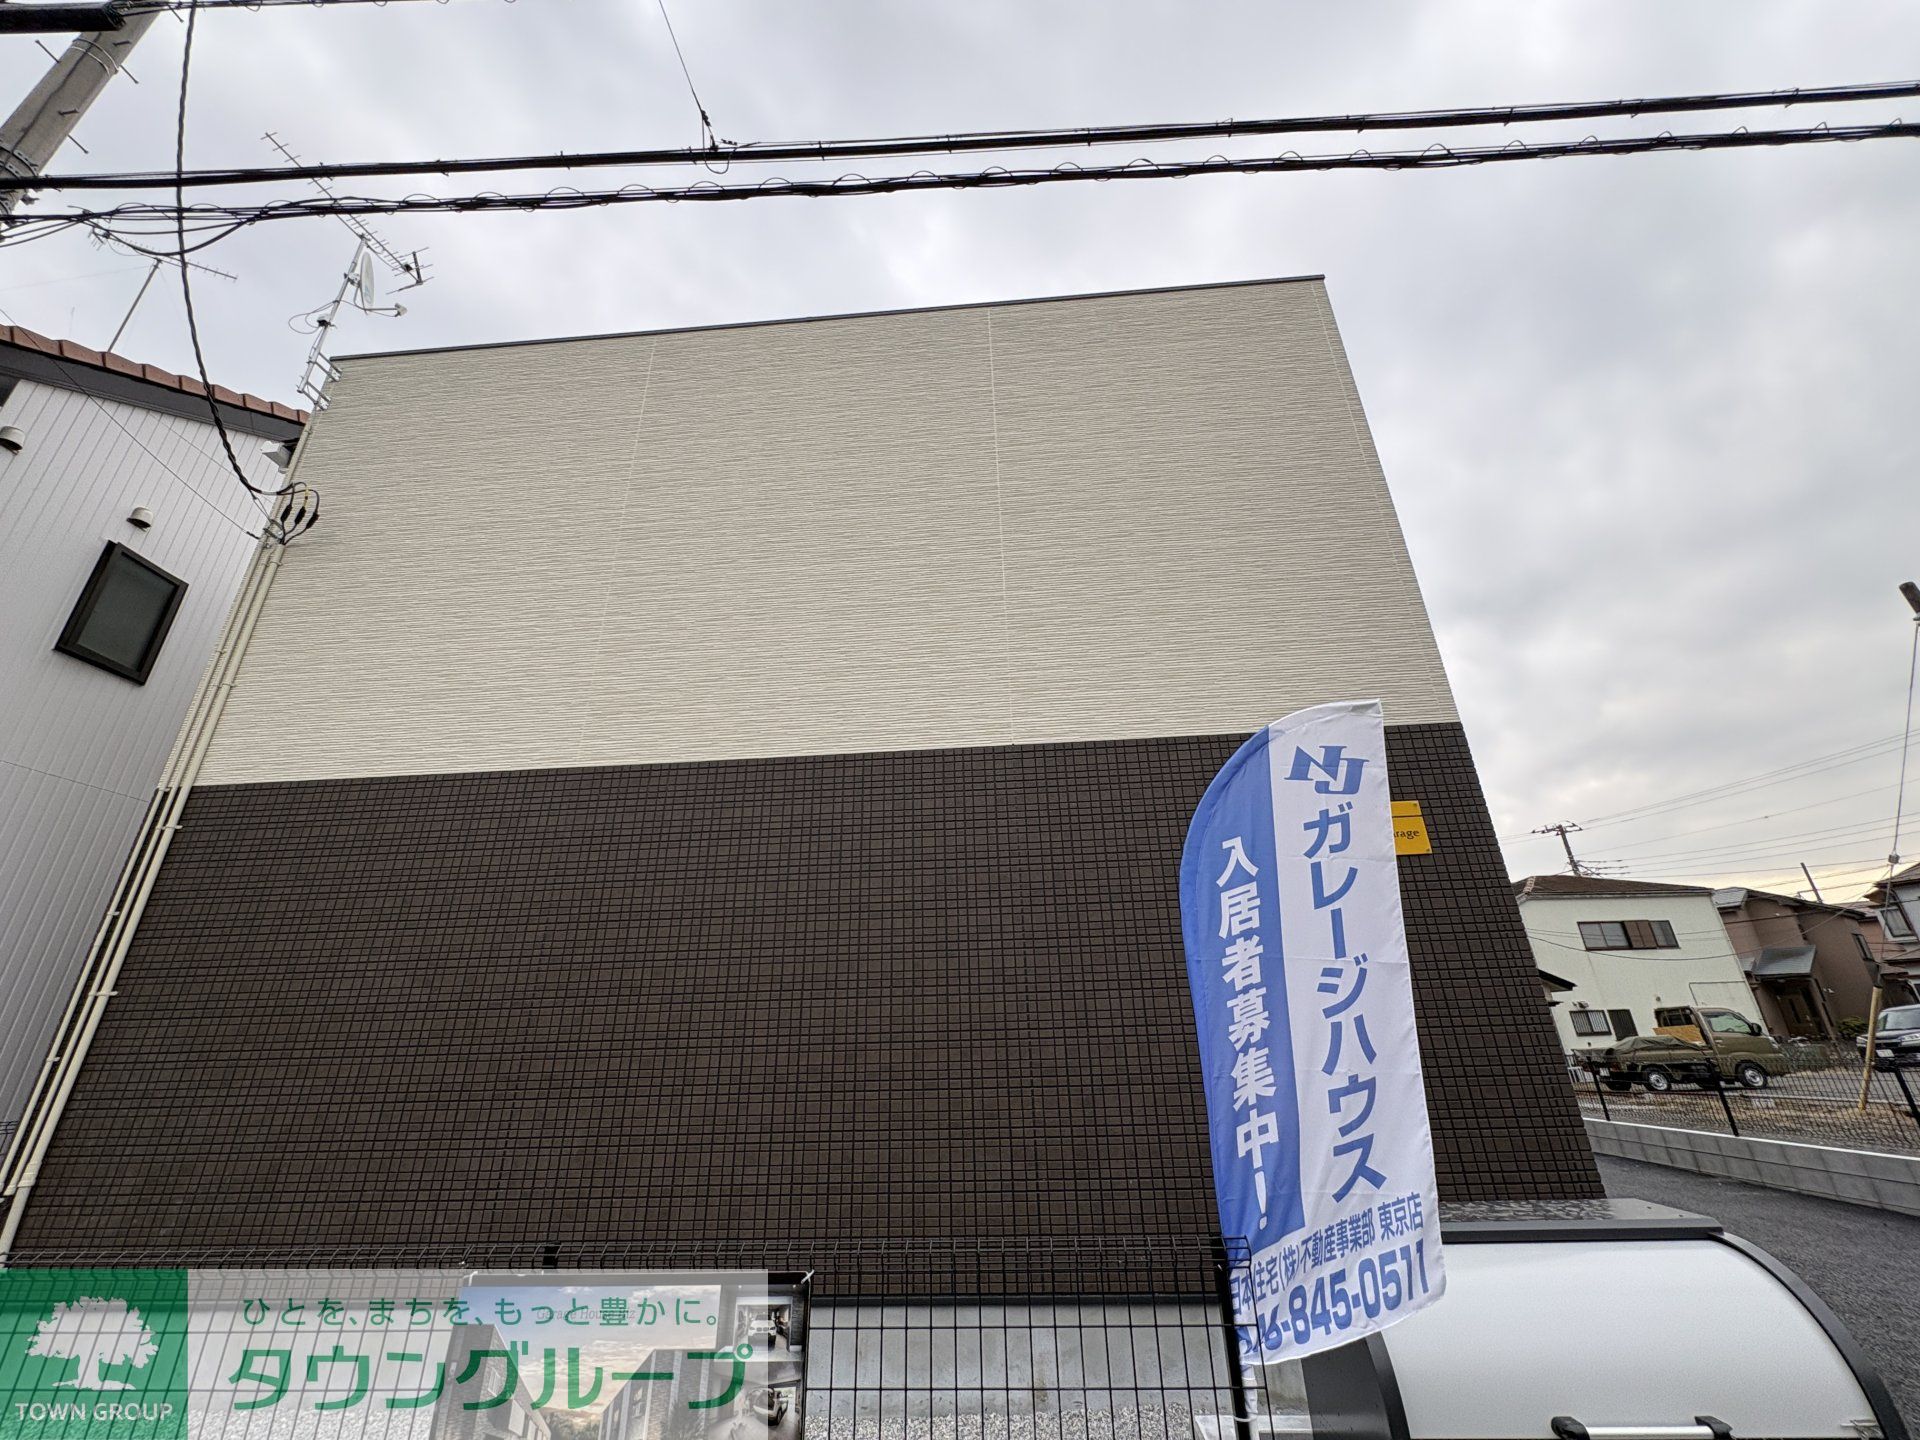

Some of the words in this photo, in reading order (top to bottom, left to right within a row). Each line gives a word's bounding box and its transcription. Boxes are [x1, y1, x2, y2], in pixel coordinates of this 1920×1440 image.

[1284, 745, 1370, 795] NJ
[1394, 830, 1420, 840] rage
[1303, 801, 1387, 1203] ガレージハウス
[1216, 836, 1279, 1231] 入居者募集中！
[1378, 1191, 1424, 1241] 東京店
